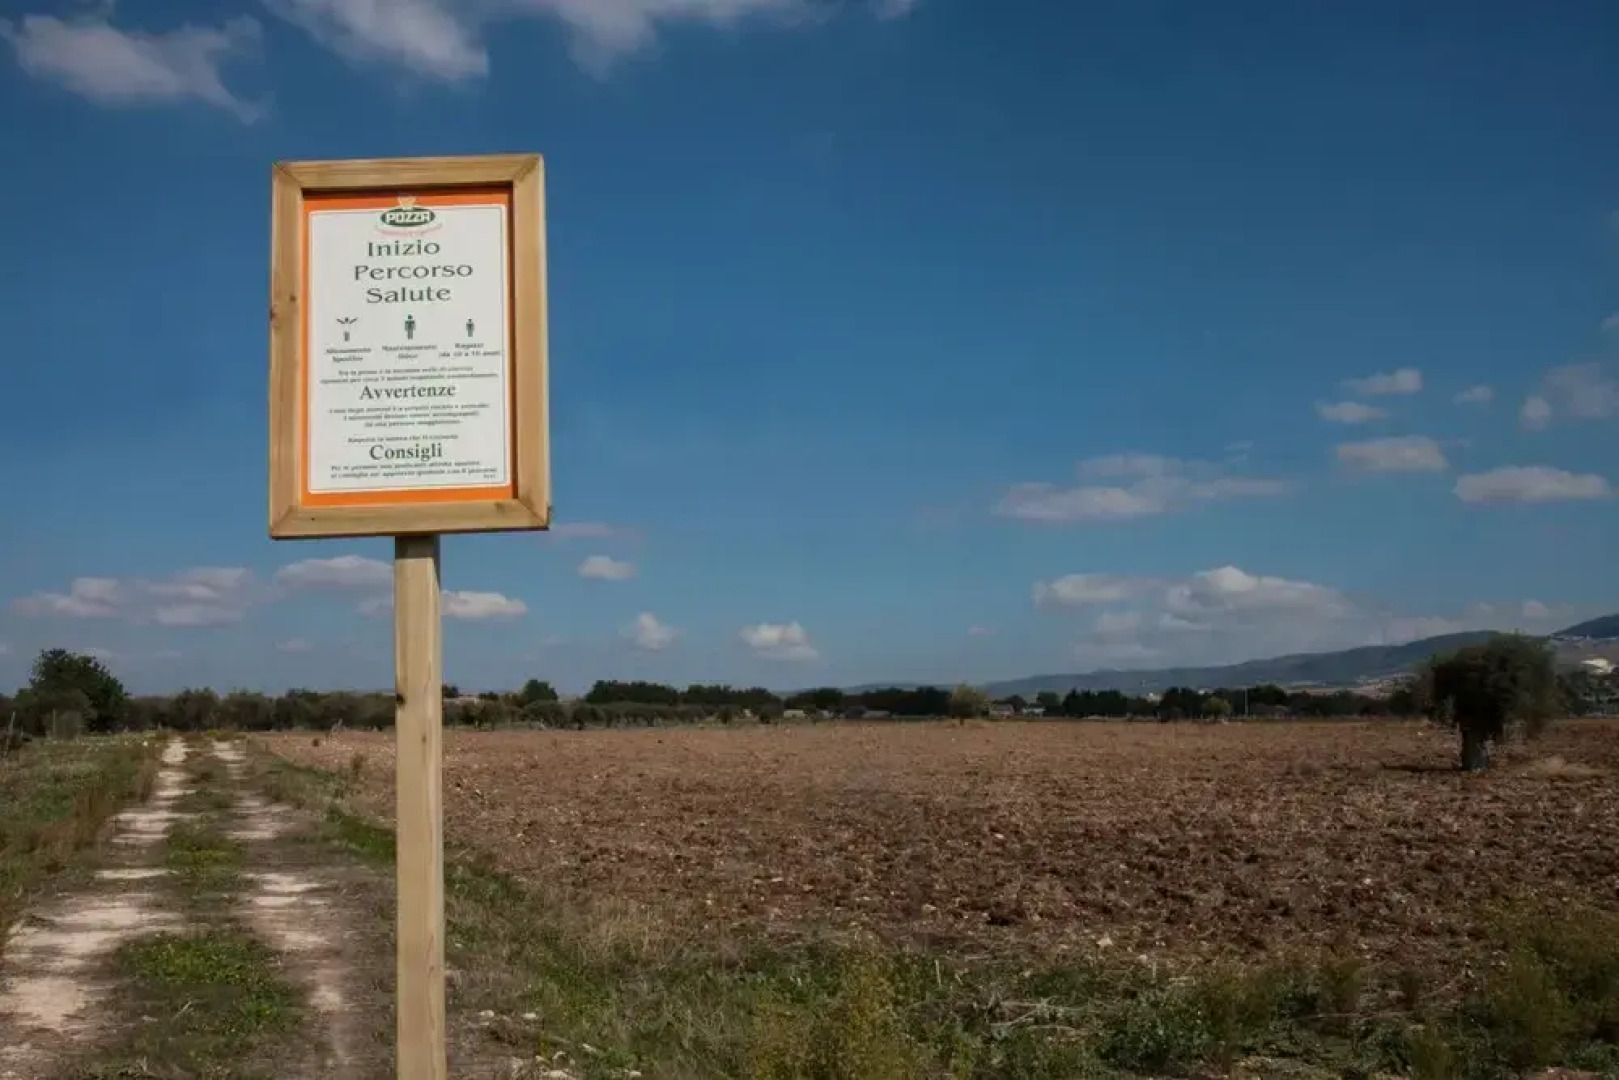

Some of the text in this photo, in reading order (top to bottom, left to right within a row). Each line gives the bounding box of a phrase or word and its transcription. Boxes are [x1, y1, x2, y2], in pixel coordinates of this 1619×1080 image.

[367, 239, 441, 257] Inizio
[354, 263, 473, 281] Percorso
[366, 286, 451, 304] Salute
[359, 384, 456, 400] Avvertenze
[369, 442, 443, 462] Consigli
